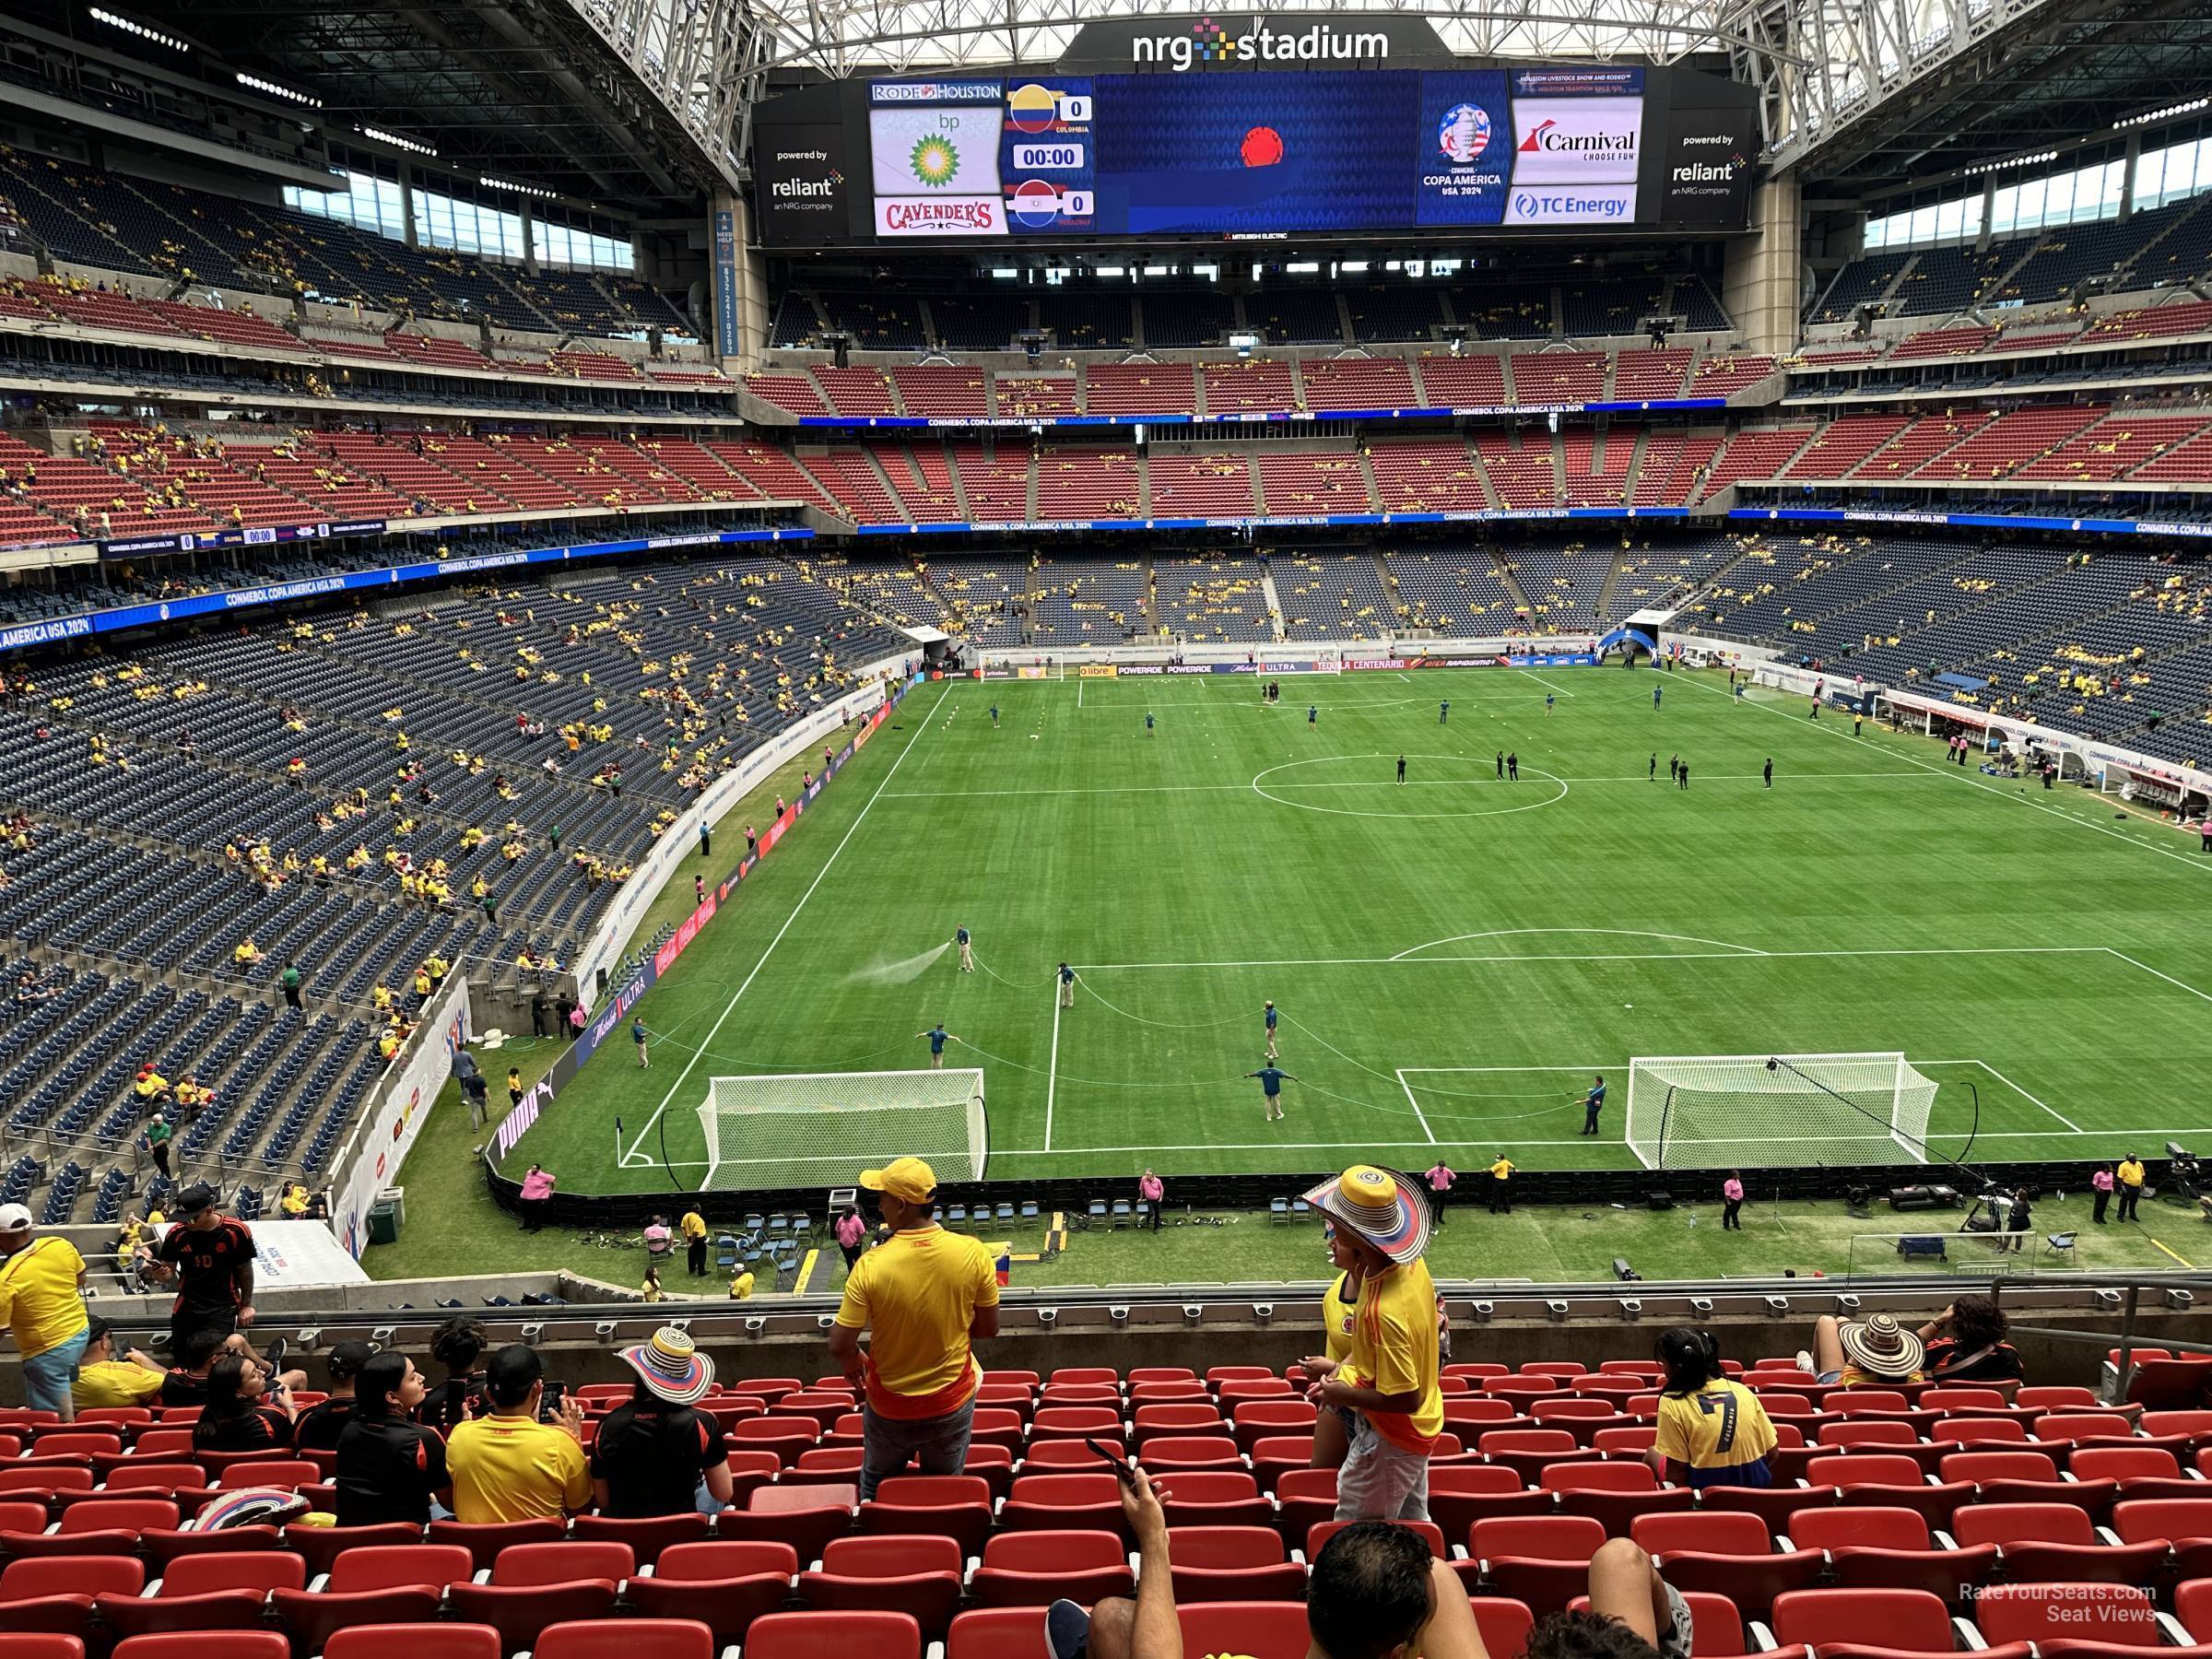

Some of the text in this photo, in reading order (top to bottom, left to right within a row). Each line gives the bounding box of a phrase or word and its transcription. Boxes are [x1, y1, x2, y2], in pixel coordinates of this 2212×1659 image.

[1133, 25, 1388, 72] nrg stadium
[1071, 100, 1082, 117] 0
[938, 113, 960, 132] bp
[1546, 131, 1634, 151] Carnival
[1682, 134, 1734, 147] powered by
[776, 149, 828, 162] powered by
[1023, 148, 1075, 166] 00:00
[1583, 152, 1634, 160] CHOOSE FUN
[1673, 162, 1734, 182] reliant
[1423, 174, 1501, 186] COPA AMERICA
[771, 178, 833, 196] reliant
[1441, 186, 1482, 196] USA 2024
[1681, 187, 1699, 195] NRG
[1699, 186, 1731, 197] company
[783, 201, 800, 210] NRG
[800, 202, 833, 214] company
[1072, 195, 1084, 212] 0
[1540, 197, 1628, 217] TC Energy
[886, 200, 993, 230] CAVENDER'S
[1452, 407, 1494, 417] CONMEBOL
[1494, 406, 1514, 415] COPA
[1513, 406, 1549, 414] AMERICA
[1549, 405, 1564, 413] USA
[928, 418, 1057, 427] CONMEBOL COPA AMERICA USA 2024
[1245, 518, 1265, 526] COPA
[1443, 512, 1484, 521] CONMEBOL
[1844, 512, 1947, 524] CONMEBOL COPA AMERICA USA 2024
[970, 523, 1009, 531] CONMEBOL
[1075, 522, 1092, 530] 2024
[2136, 522, 2179, 534] CONMEBOL
[2179, 524, 2201, 535] COPA
[184, 536, 190, 547] 0
[250, 530, 271, 543] 00:00
[438, 553, 528, 573] CONMEBOL COPA AMERICA USA 2024
[226, 578, 346, 606] CONMEBOL COPA AMERICA USA 2024
[3, 618, 89, 647] AMERICA USA 2024
[1088, 665, 1109, 675] libre
[1118, 666, 1163, 675] POWERADE
[1168, 665, 1212, 675] POWERADE
[1266, 663, 1296, 672] ULTRA
[1353, 659, 1405, 669] CENTENARIO
[2088, 749, 2116, 764] CONMEBOL
[621, 975, 646, 1011] ULTRA
[498, 1088, 539, 1160] PUMA
[194, 1254, 213, 1268] 10
[1696, 1391, 1738, 1453] 7
[1724, 1407, 1735, 1442] COLOMBIA
